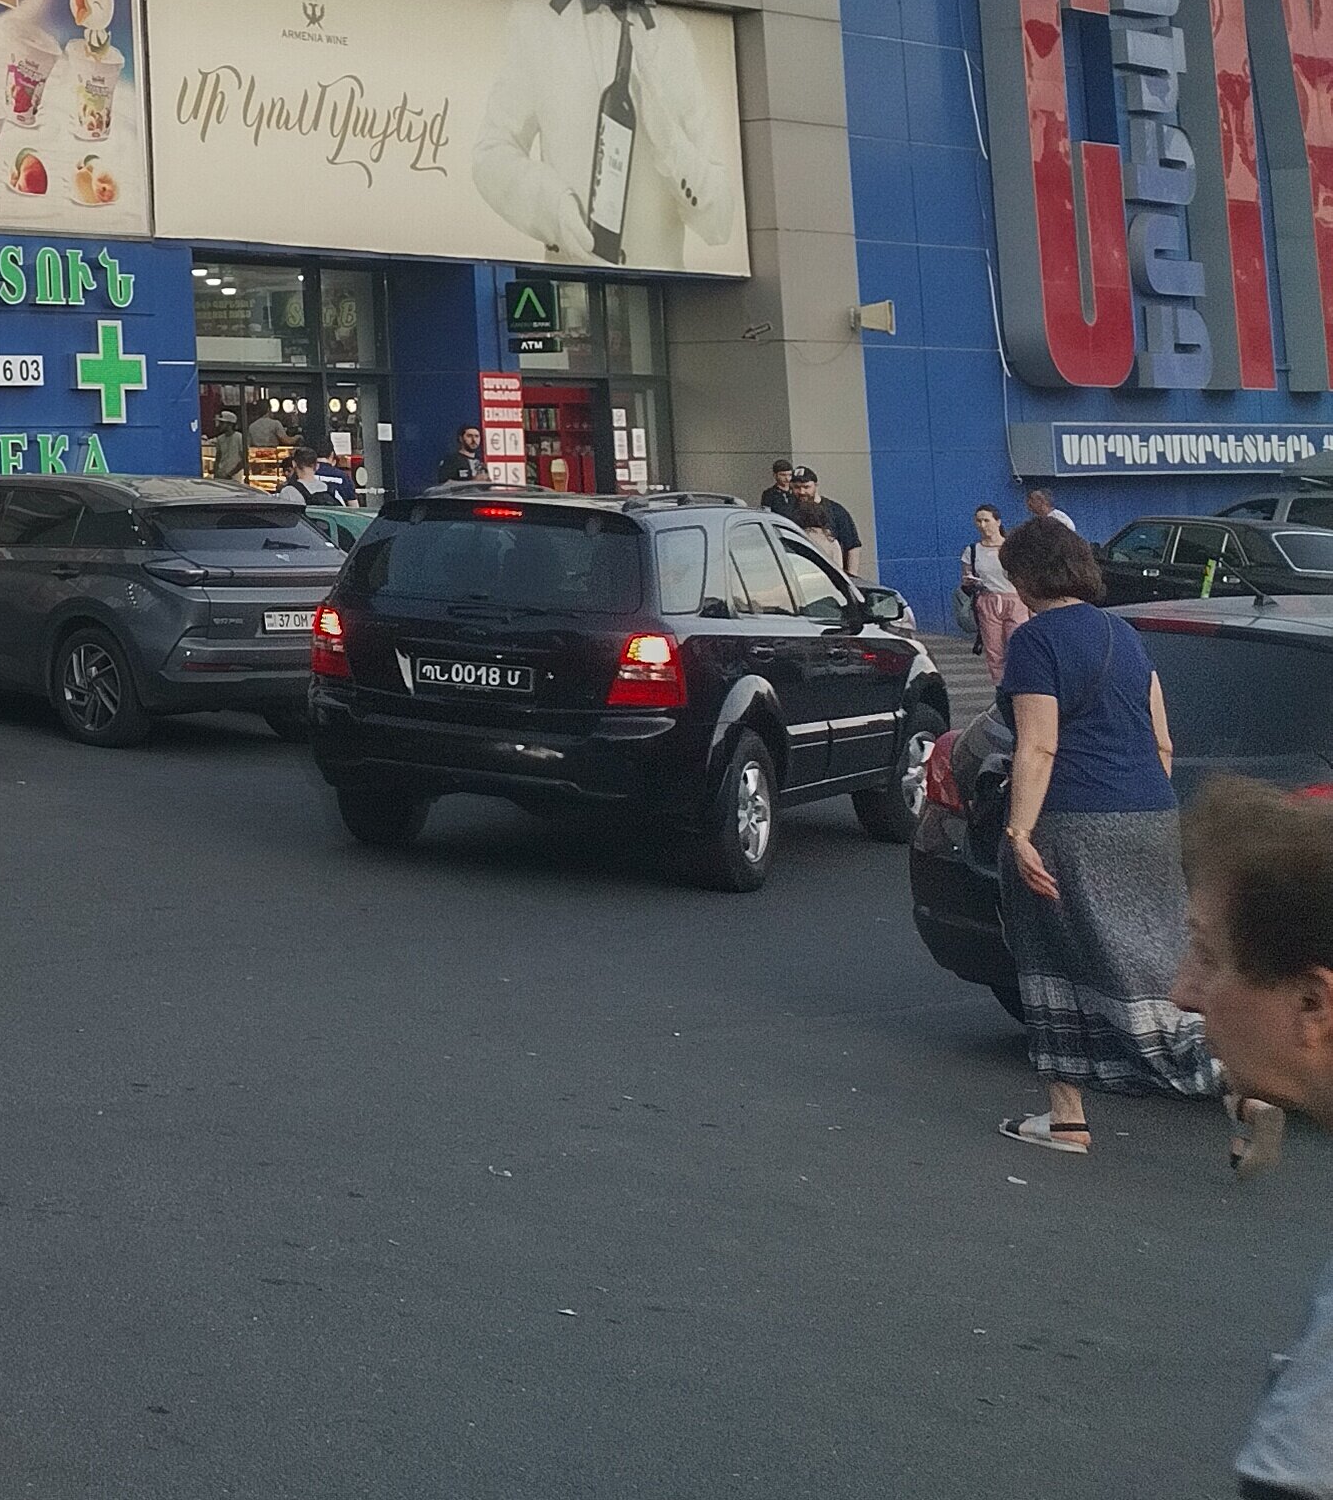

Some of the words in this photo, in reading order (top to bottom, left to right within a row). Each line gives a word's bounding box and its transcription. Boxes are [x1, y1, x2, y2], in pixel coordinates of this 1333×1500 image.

[282, 29, 324, 43] ARMENIA
[325, 34, 349, 46] WINE
[520, 341, 543, 350] ATM
[19, 359, 41, 382] 03
[278, 614, 290, 627] 37
[293, 614, 308, 627] OM
[451, 663, 501, 686] 0018
